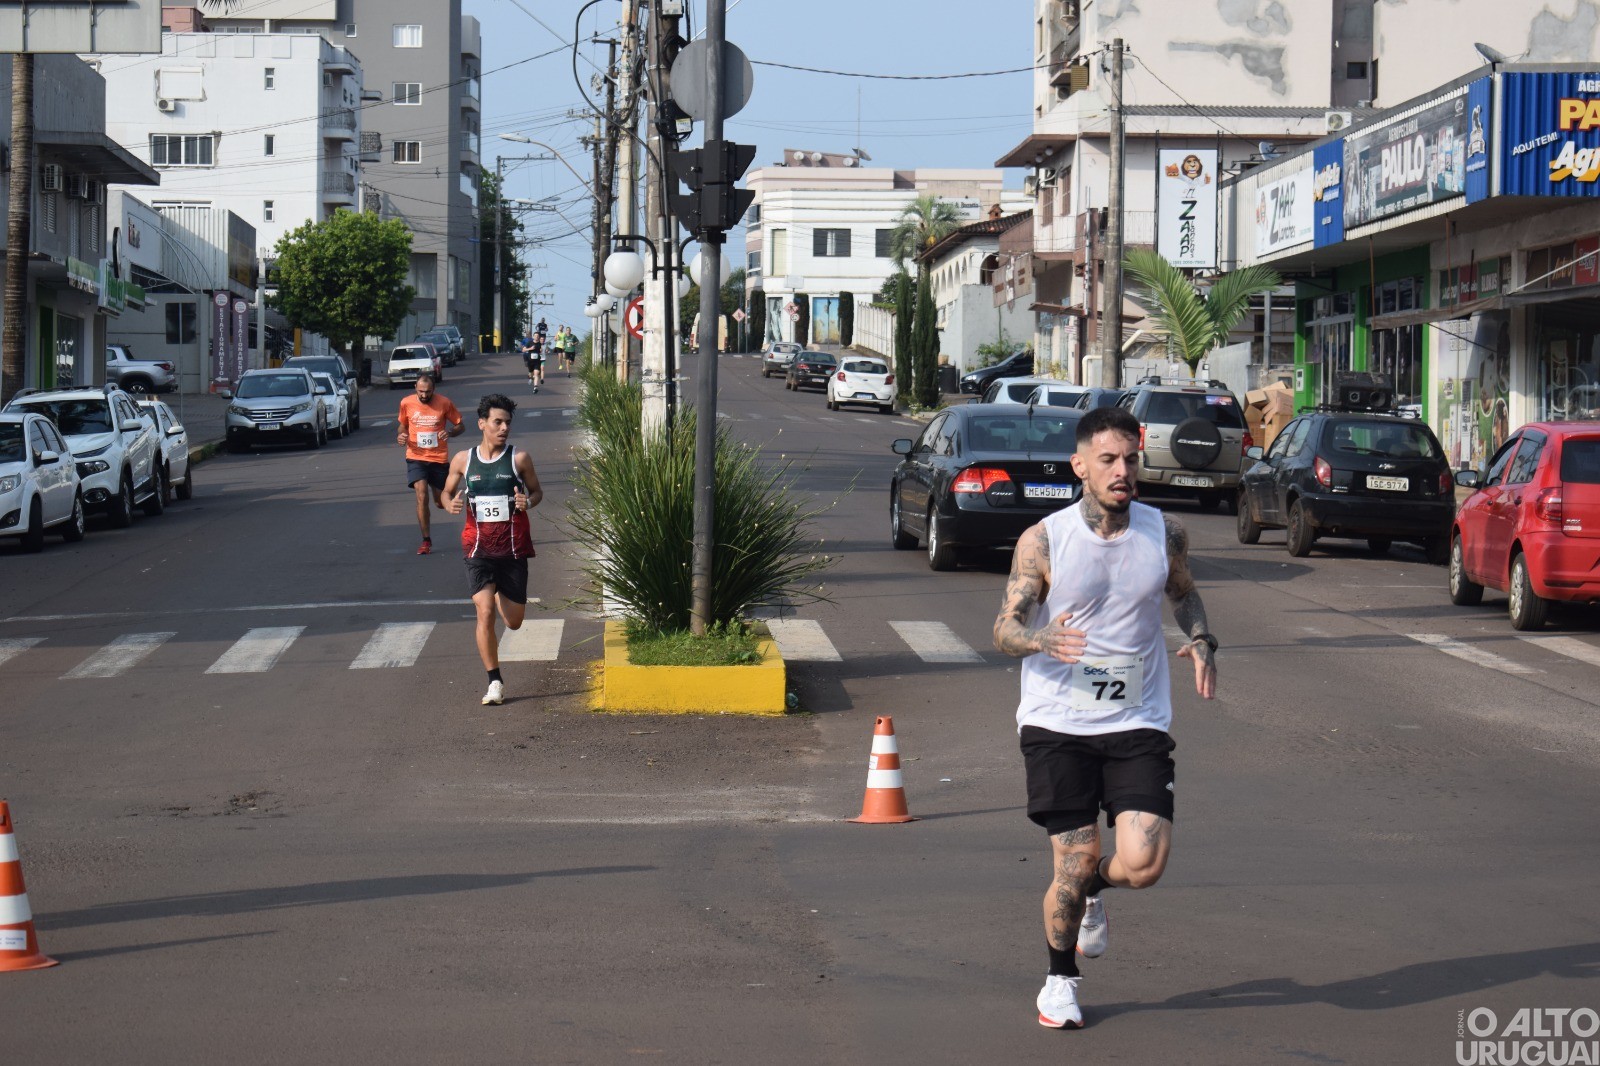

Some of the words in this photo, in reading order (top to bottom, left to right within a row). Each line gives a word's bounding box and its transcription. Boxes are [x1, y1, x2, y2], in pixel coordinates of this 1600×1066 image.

[1512, 140, 1534, 156] AQUI
[1534, 131, 1558, 147] TEM!
[1381, 134, 1425, 192] PAULO
[1269, 181, 1296, 245] ZAAP
[1179, 200, 1198, 258] ZAAP
[422, 438, 433, 446] 59
[1028, 487, 1067, 497] MEW5D77
[484, 507, 500, 517] 35
[1083, 666, 1109, 675] Sesc
[1092, 681, 1126, 701] 72
